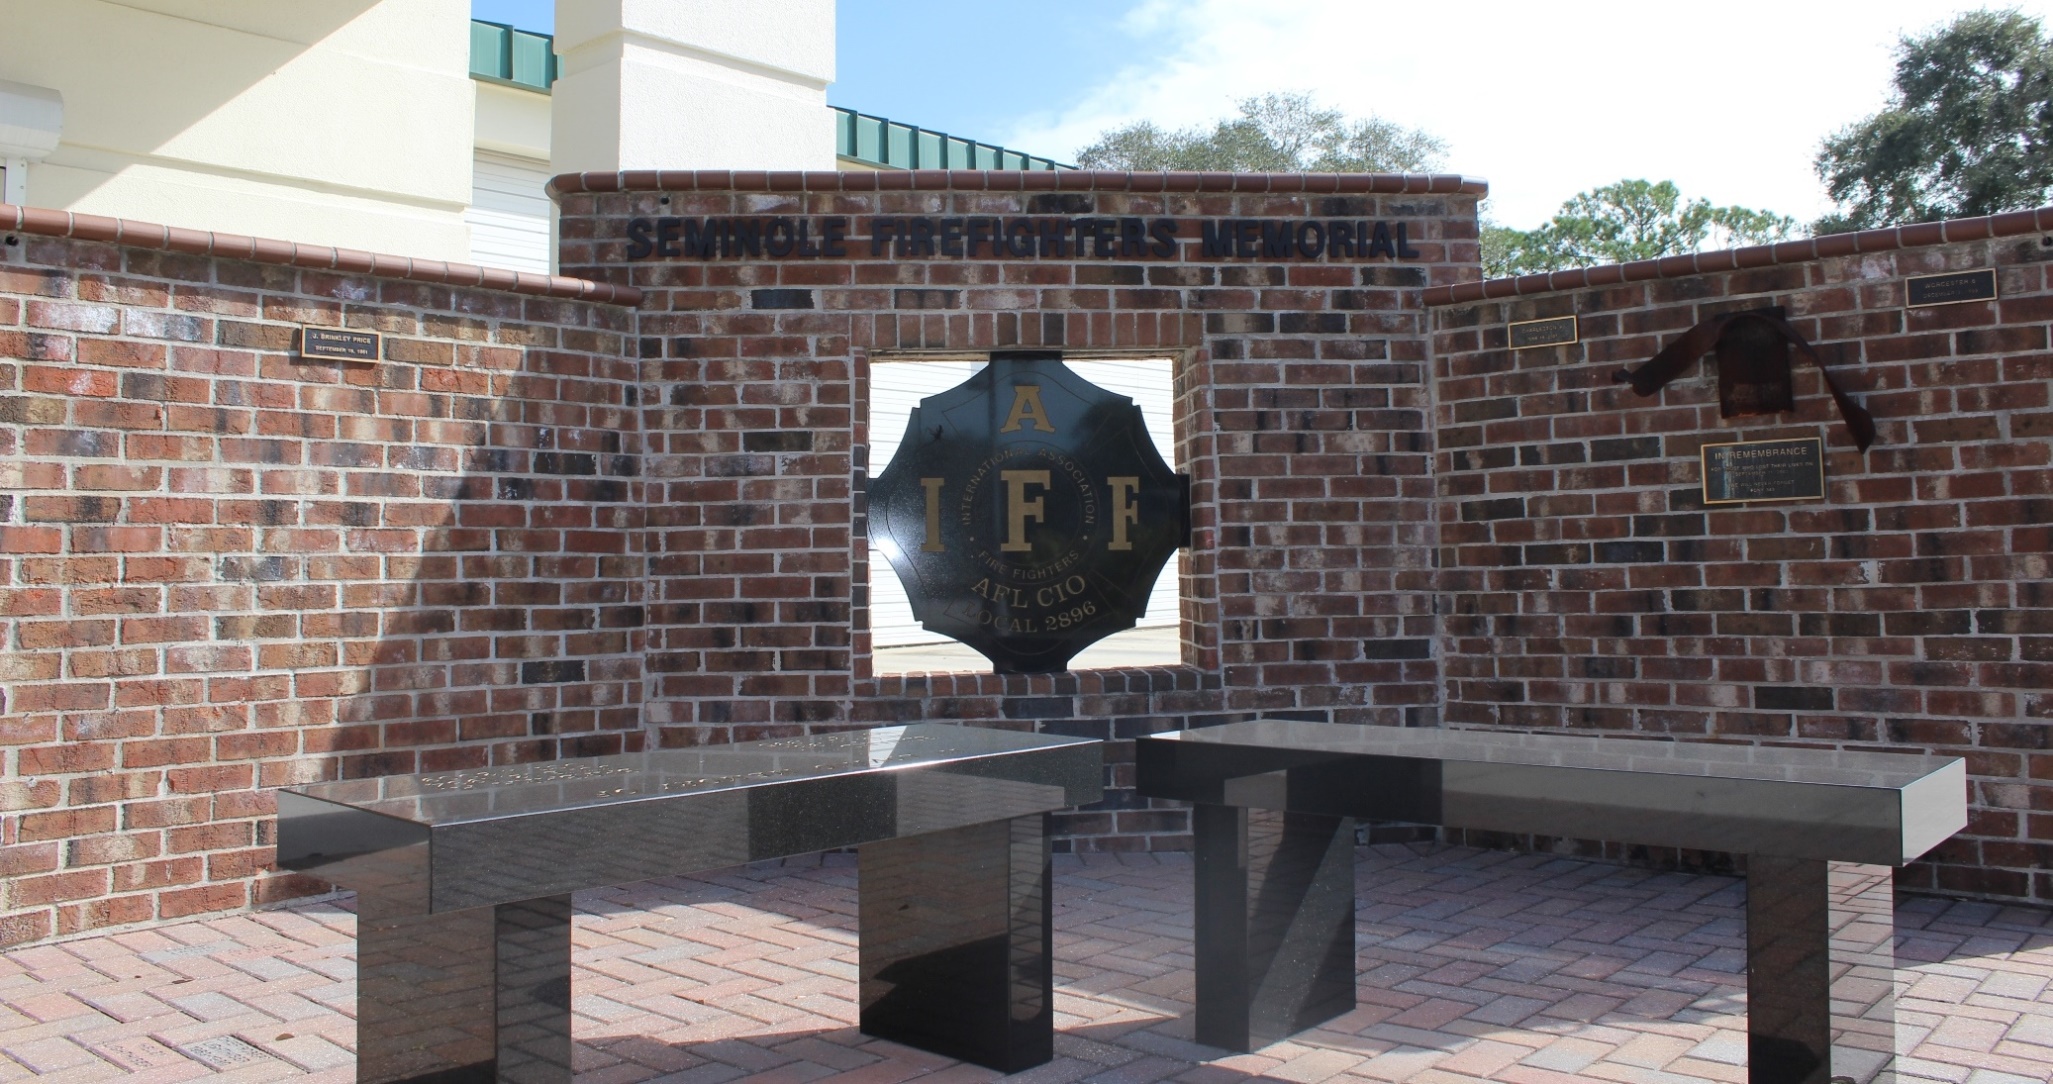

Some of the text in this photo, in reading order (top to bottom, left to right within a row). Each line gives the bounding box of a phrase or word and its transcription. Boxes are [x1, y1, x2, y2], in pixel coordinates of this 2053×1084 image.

[627, 217, 1420, 260] SEMINOLE FIREFIGHTERS MEMORIAL
[321, 333, 351, 342] BRINKLEY
[1000, 384, 1056, 434] A
[1730, 446, 1808, 459] REMEMBRANCE
[1037, 447, 1096, 526] ASSOCIATION
[920, 469, 1140, 552] I F F
[978, 550, 1080, 580] FIRE FIGHTERS
[970, 573, 1087, 608] AFL CIO
[962, 600, 1097, 633] LOCAL 2896
